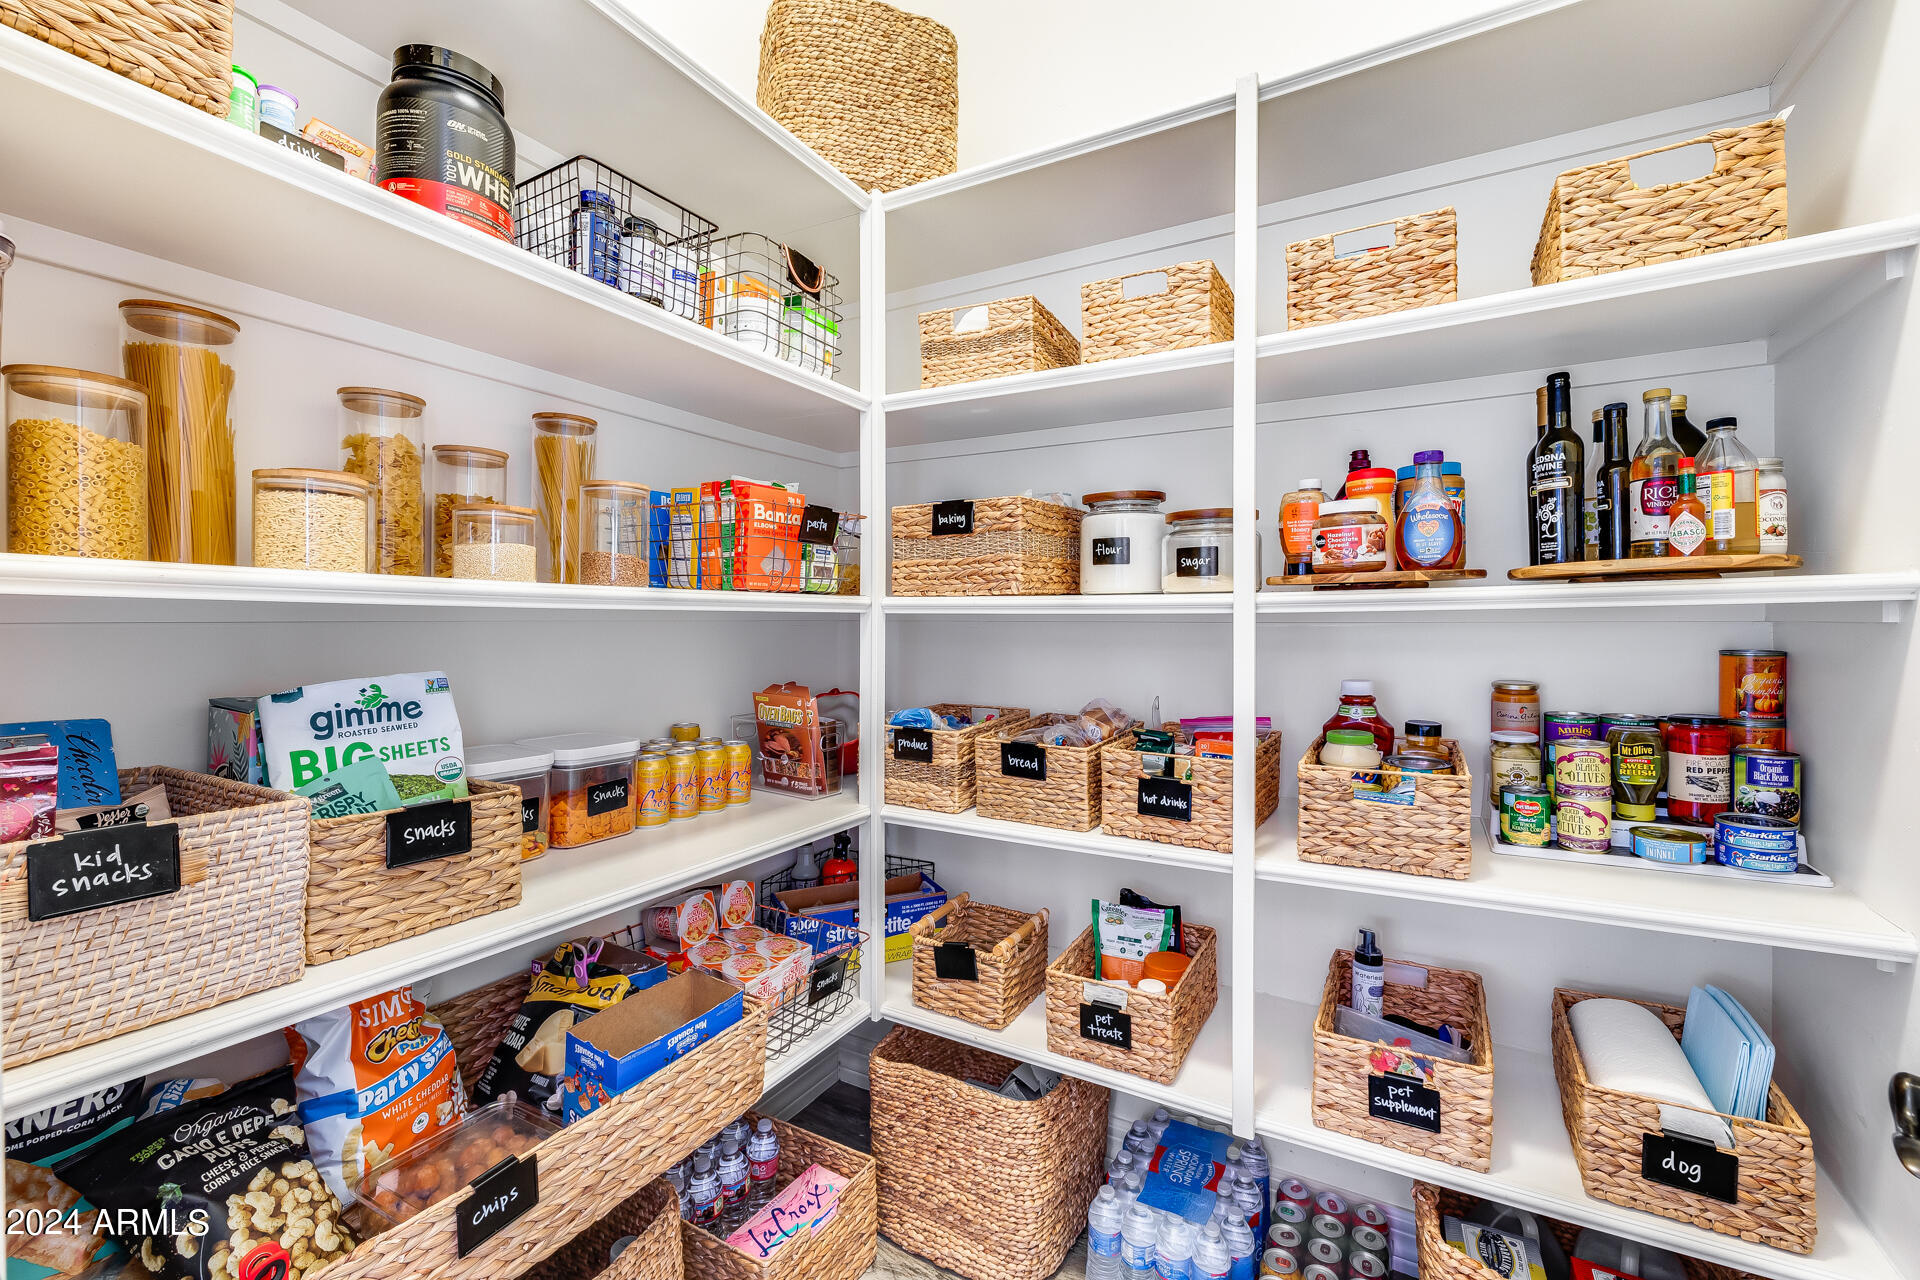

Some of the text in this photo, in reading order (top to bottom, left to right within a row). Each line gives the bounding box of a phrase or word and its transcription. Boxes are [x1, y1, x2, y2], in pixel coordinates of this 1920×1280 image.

[278, 134, 322, 161] drink
[446, 149, 510, 187] GOLD STANDARD
[457, 162, 514, 215] WHEY
[1536, 452, 1566, 463] EDONA
[1643, 486, 1679, 501] RICE
[753, 503, 801, 525] Banza
[938, 510, 967, 528] baking
[806, 518, 828, 533] pasta
[1095, 543, 1124, 557] flour
[1180, 555, 1211, 570] sugar
[309, 700, 424, 741] gimme
[758, 703, 780, 721] OVEN
[779, 705, 804, 727] BAGS
[337, 722, 419, 739] ROASTED SEAWEED
[1558, 725, 1593, 737] Annie's
[897, 738, 929, 752] produce
[1633, 744, 1653, 755] Olive
[66, 734, 113, 806] Chocolov
[289, 736, 451, 789] BIG SHEETS
[440, 762, 458, 770] USDA
[1007, 754, 1038, 771] bread
[1575, 763, 1600, 772] BLACK
[1619, 769, 1656, 777] RELISH
[1760, 764, 1784, 773] Organic
[1569, 771, 1606, 784] OLIVES
[1753, 772, 1789, 782] Black Beans
[1143, 792, 1188, 810] hot drinks
[1561, 813, 1584, 824] BLACK
[403, 819, 456, 845] snacks
[1740, 830, 1780, 840] StarKist
[73, 844, 123, 872] kid
[1749, 852, 1788, 862] StarKist
[51, 862, 154, 897] snacks
[789, 919, 819, 931] 3000
[887, 949, 912, 961] WRAP
[528, 975, 621, 1002] Smarood
[1095, 1013, 1114, 1026] pet
[1088, 1023, 1123, 1041] treats
[358, 1061, 420, 1113] Party
[381, 1073, 449, 1120] WHITE CHEDDAR
[1387, 1084, 1414, 1100] pet
[1374, 1096, 1438, 1121] supplement
[26, 1103, 124, 1146] POPPED-CORN SNACK
[173, 1105, 258, 1143] Organic
[130, 1137, 166, 1162] TRADER
[156, 1113, 275, 1171] CACIO E PEPE
[202, 1138, 258, 1165] PUFFS
[200, 1139, 281, 1184] CHEESE & PEPPER
[203, 1143, 290, 1194] CORN & RICE SNACKS
[1162, 1152, 1175, 1173] WATER
[1169, 1149, 1191, 1183] SPRING
[1661, 1150, 1702, 1183] dog
[472, 1186, 519, 1226] chips
[748, 1184, 828, 1258] La Croix
